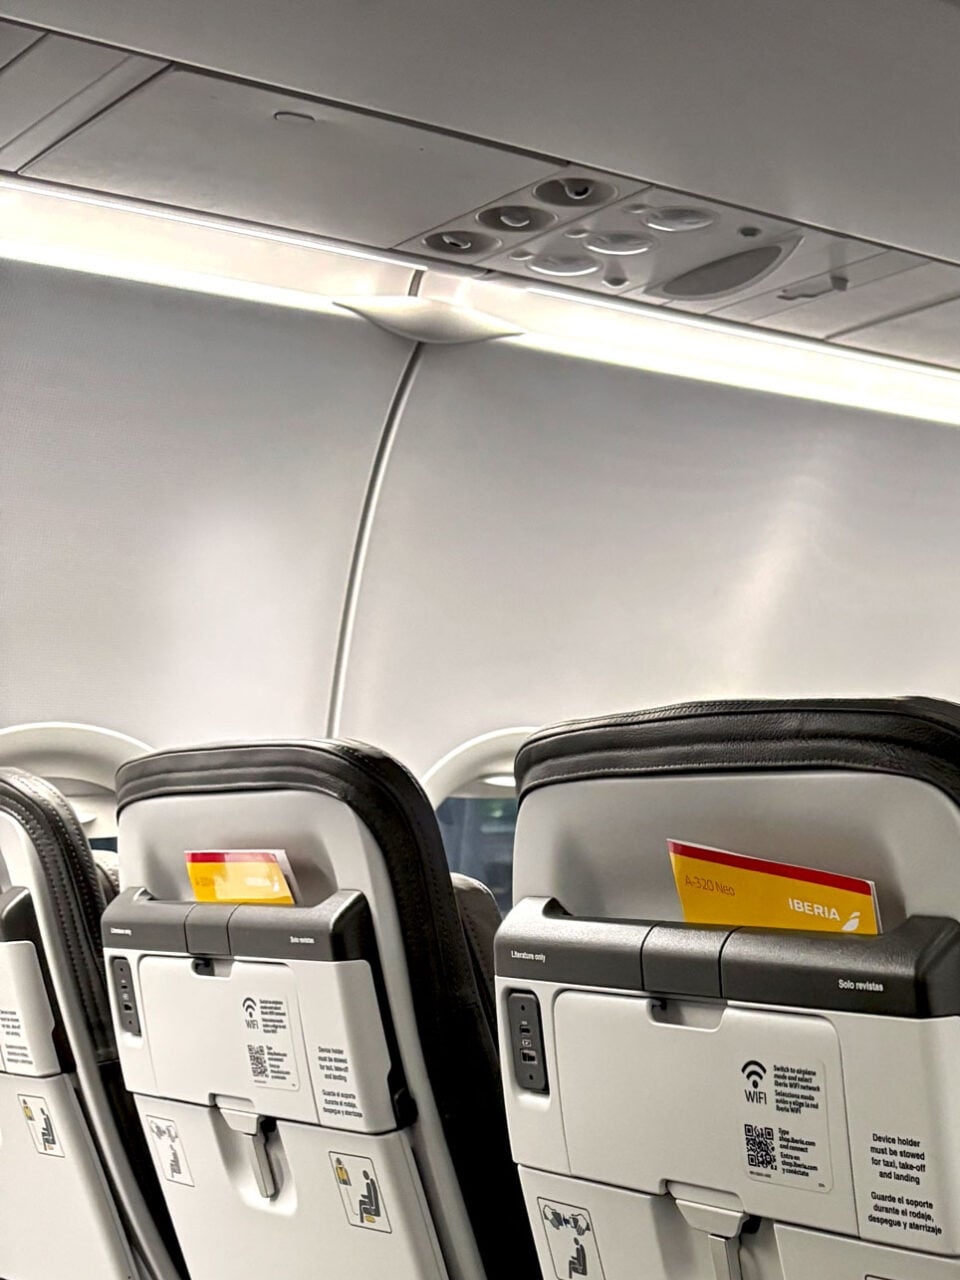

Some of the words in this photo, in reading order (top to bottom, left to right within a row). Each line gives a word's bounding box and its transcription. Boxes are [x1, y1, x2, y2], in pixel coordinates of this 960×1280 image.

[685, 875, 714, 892] A-320
[788, 897, 841, 921] IBERIA
[510, 949, 534, 961] Literature
[535, 953, 546, 963] only
[838, 979, 855, 989] Solo
[855, 981, 884, 992] revistas
[744, 1089, 767, 1105] WIFI
[872, 1133, 896, 1144] Device
[897, 1136, 920, 1147] holder
[870, 1146, 888, 1155] must
[889, 1148, 898, 1156] be
[899, 1150, 925, 1160] stowed
[871, 1157, 881, 1166] for
[883, 1159, 898, 1169] taxi,
[899, 1161, 926, 1172] take-off
[879, 1170, 892, 1179] and
[893, 1172, 920, 1185] landing
[871, 1191, 896, 1203] Guarde
[898, 1196, 904, 1204] el
[905, 1198, 934, 1209] soporte
[873, 1203, 900, 1215] durante
[901, 1208, 908, 1216] el
[909, 1210, 934, 1222] rodaje,
[868, 1214, 901, 1227] despegue
[903, 1221, 907, 1230] y
[909, 1222, 942, 1236] aterrizaje
